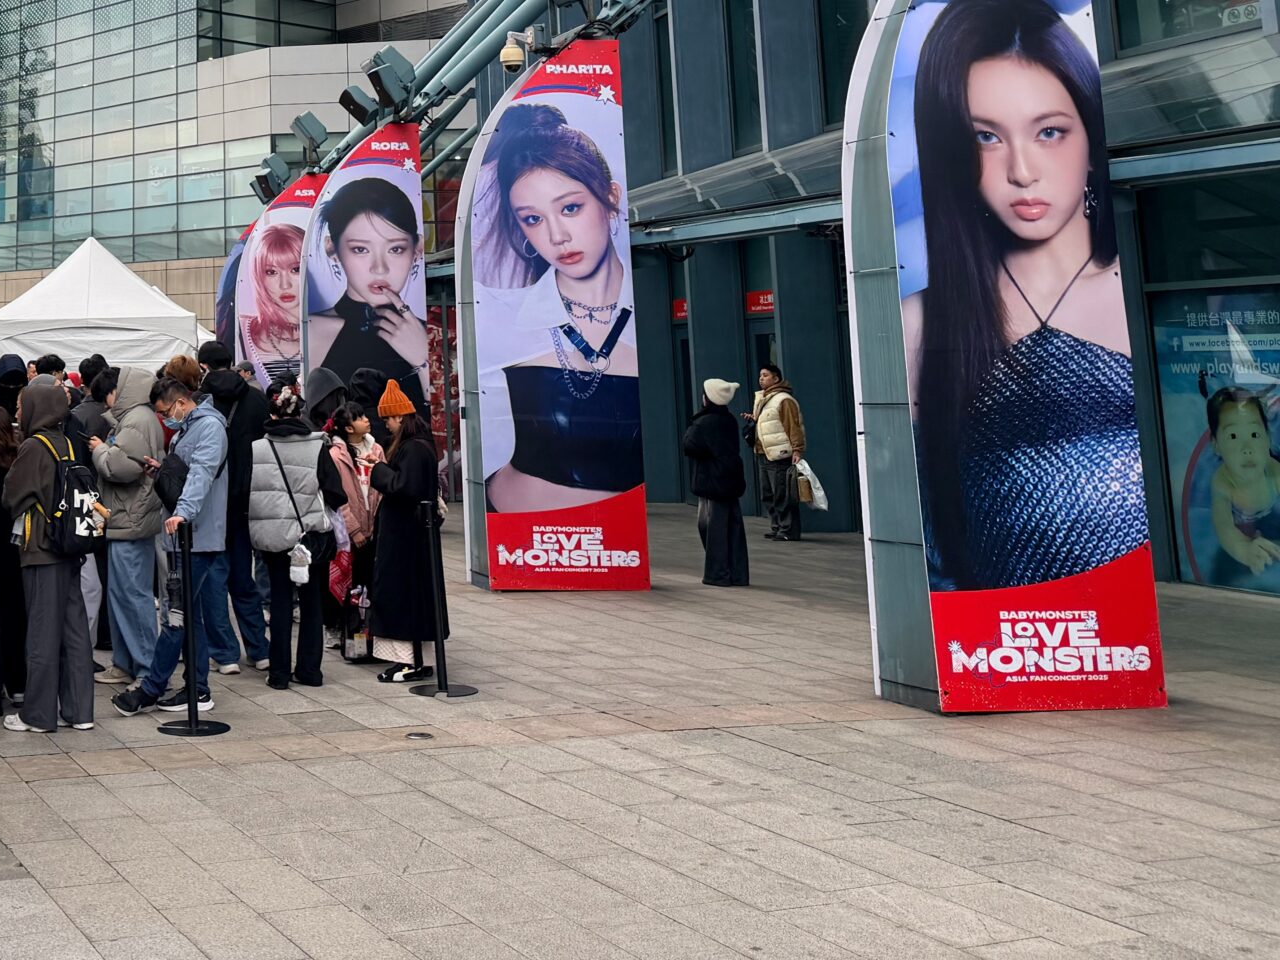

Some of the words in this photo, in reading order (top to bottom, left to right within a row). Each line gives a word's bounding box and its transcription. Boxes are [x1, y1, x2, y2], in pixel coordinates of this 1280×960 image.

[545, 64, 614, 75] PHARITA
[370, 141, 410, 151] RORA
[294, 189, 316, 197] ASA
[532, 525, 603, 533] BABYMONSTER
[532, 532, 604, 551] LOVE
[497, 548, 642, 568] MONSTERS
[999, 610, 1098, 620] BABYMONSTER
[1000, 621, 1101, 648] LOVE
[950, 645, 1152, 673] MONSTERS
